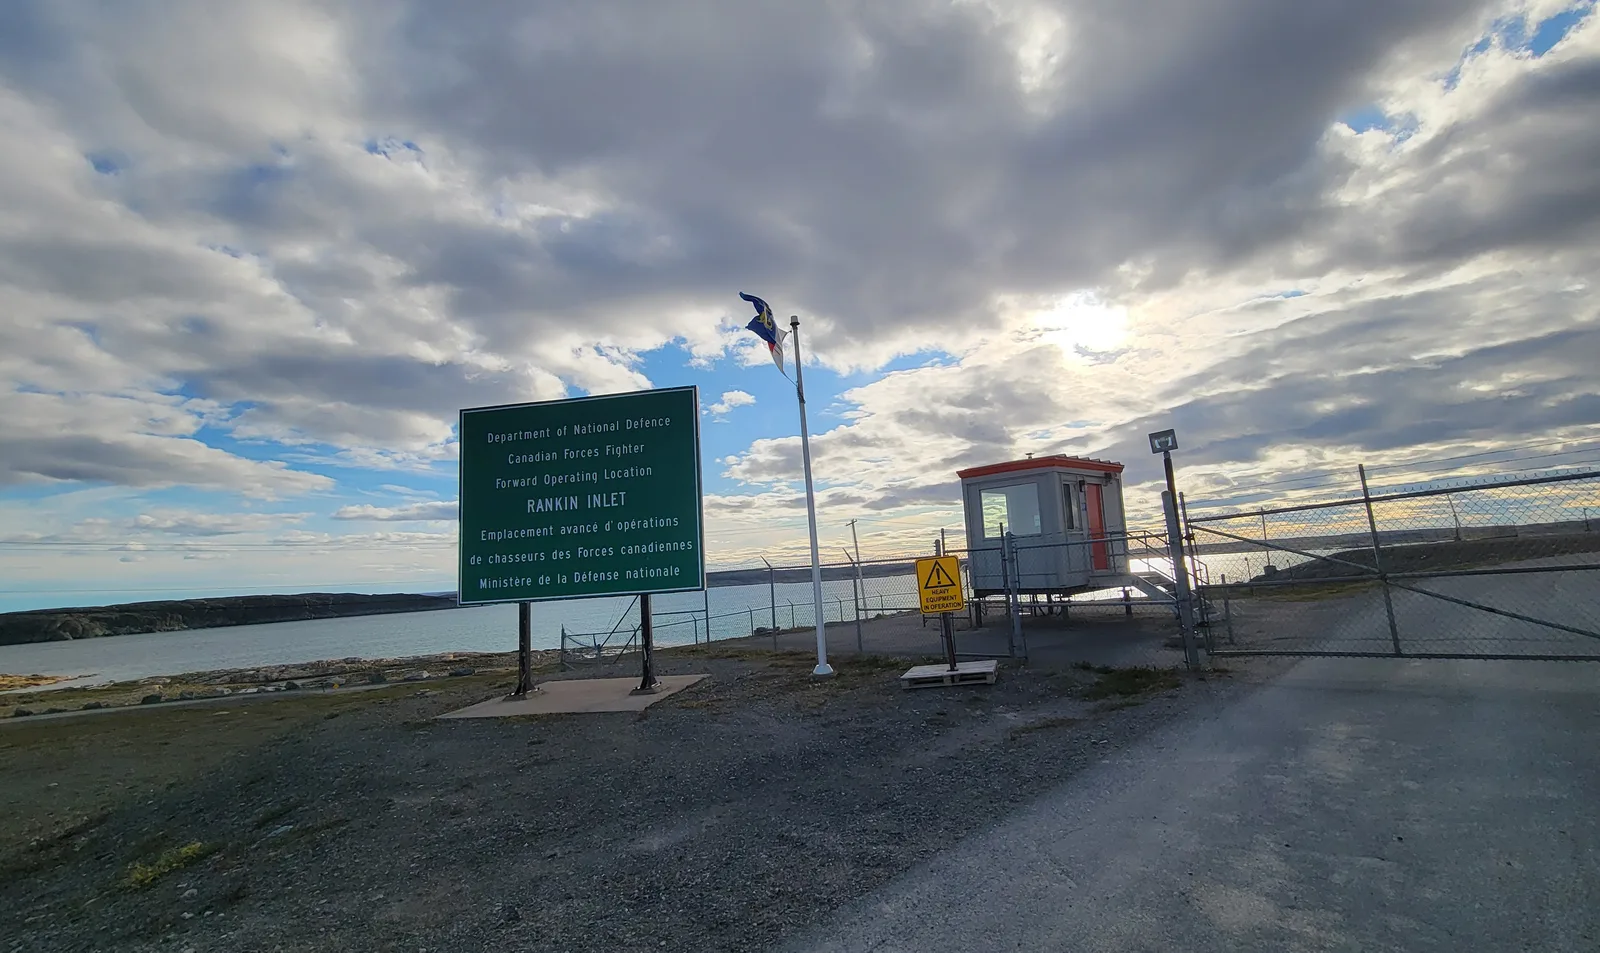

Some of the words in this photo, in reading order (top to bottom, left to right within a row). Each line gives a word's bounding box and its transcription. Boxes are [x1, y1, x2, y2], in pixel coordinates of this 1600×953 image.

[488, 427, 550, 444] Department
[557, 427, 567, 436] of
[574, 421, 619, 435] National
[626, 416, 671, 430] Defence
[508, 450, 557, 464] Canadian
[564, 447, 599, 459] Forces
[606, 443, 644, 458] Fighter
[496, 476, 537, 489] Forward
[544, 472, 598, 486] Operating
[604, 466, 652, 479] Location
[528, 496, 578, 513] RANKIN
[588, 492, 626, 508] INLET
[481, 526, 554, 542] Emplacement
[560, 521, 598, 535] avancé
[470, 554, 482, 565] de
[488, 552, 545, 564] chasseurs
[552, 549, 571, 560] des
[578, 546, 614, 558] Forces
[621, 540, 693, 554] canadiennes
[480, 574, 532, 589] Ministère
[538, 575, 551, 585] de
[557, 574, 567, 584] la
[574, 570, 619, 583] Défense
[626, 566, 680, 579] nationale
